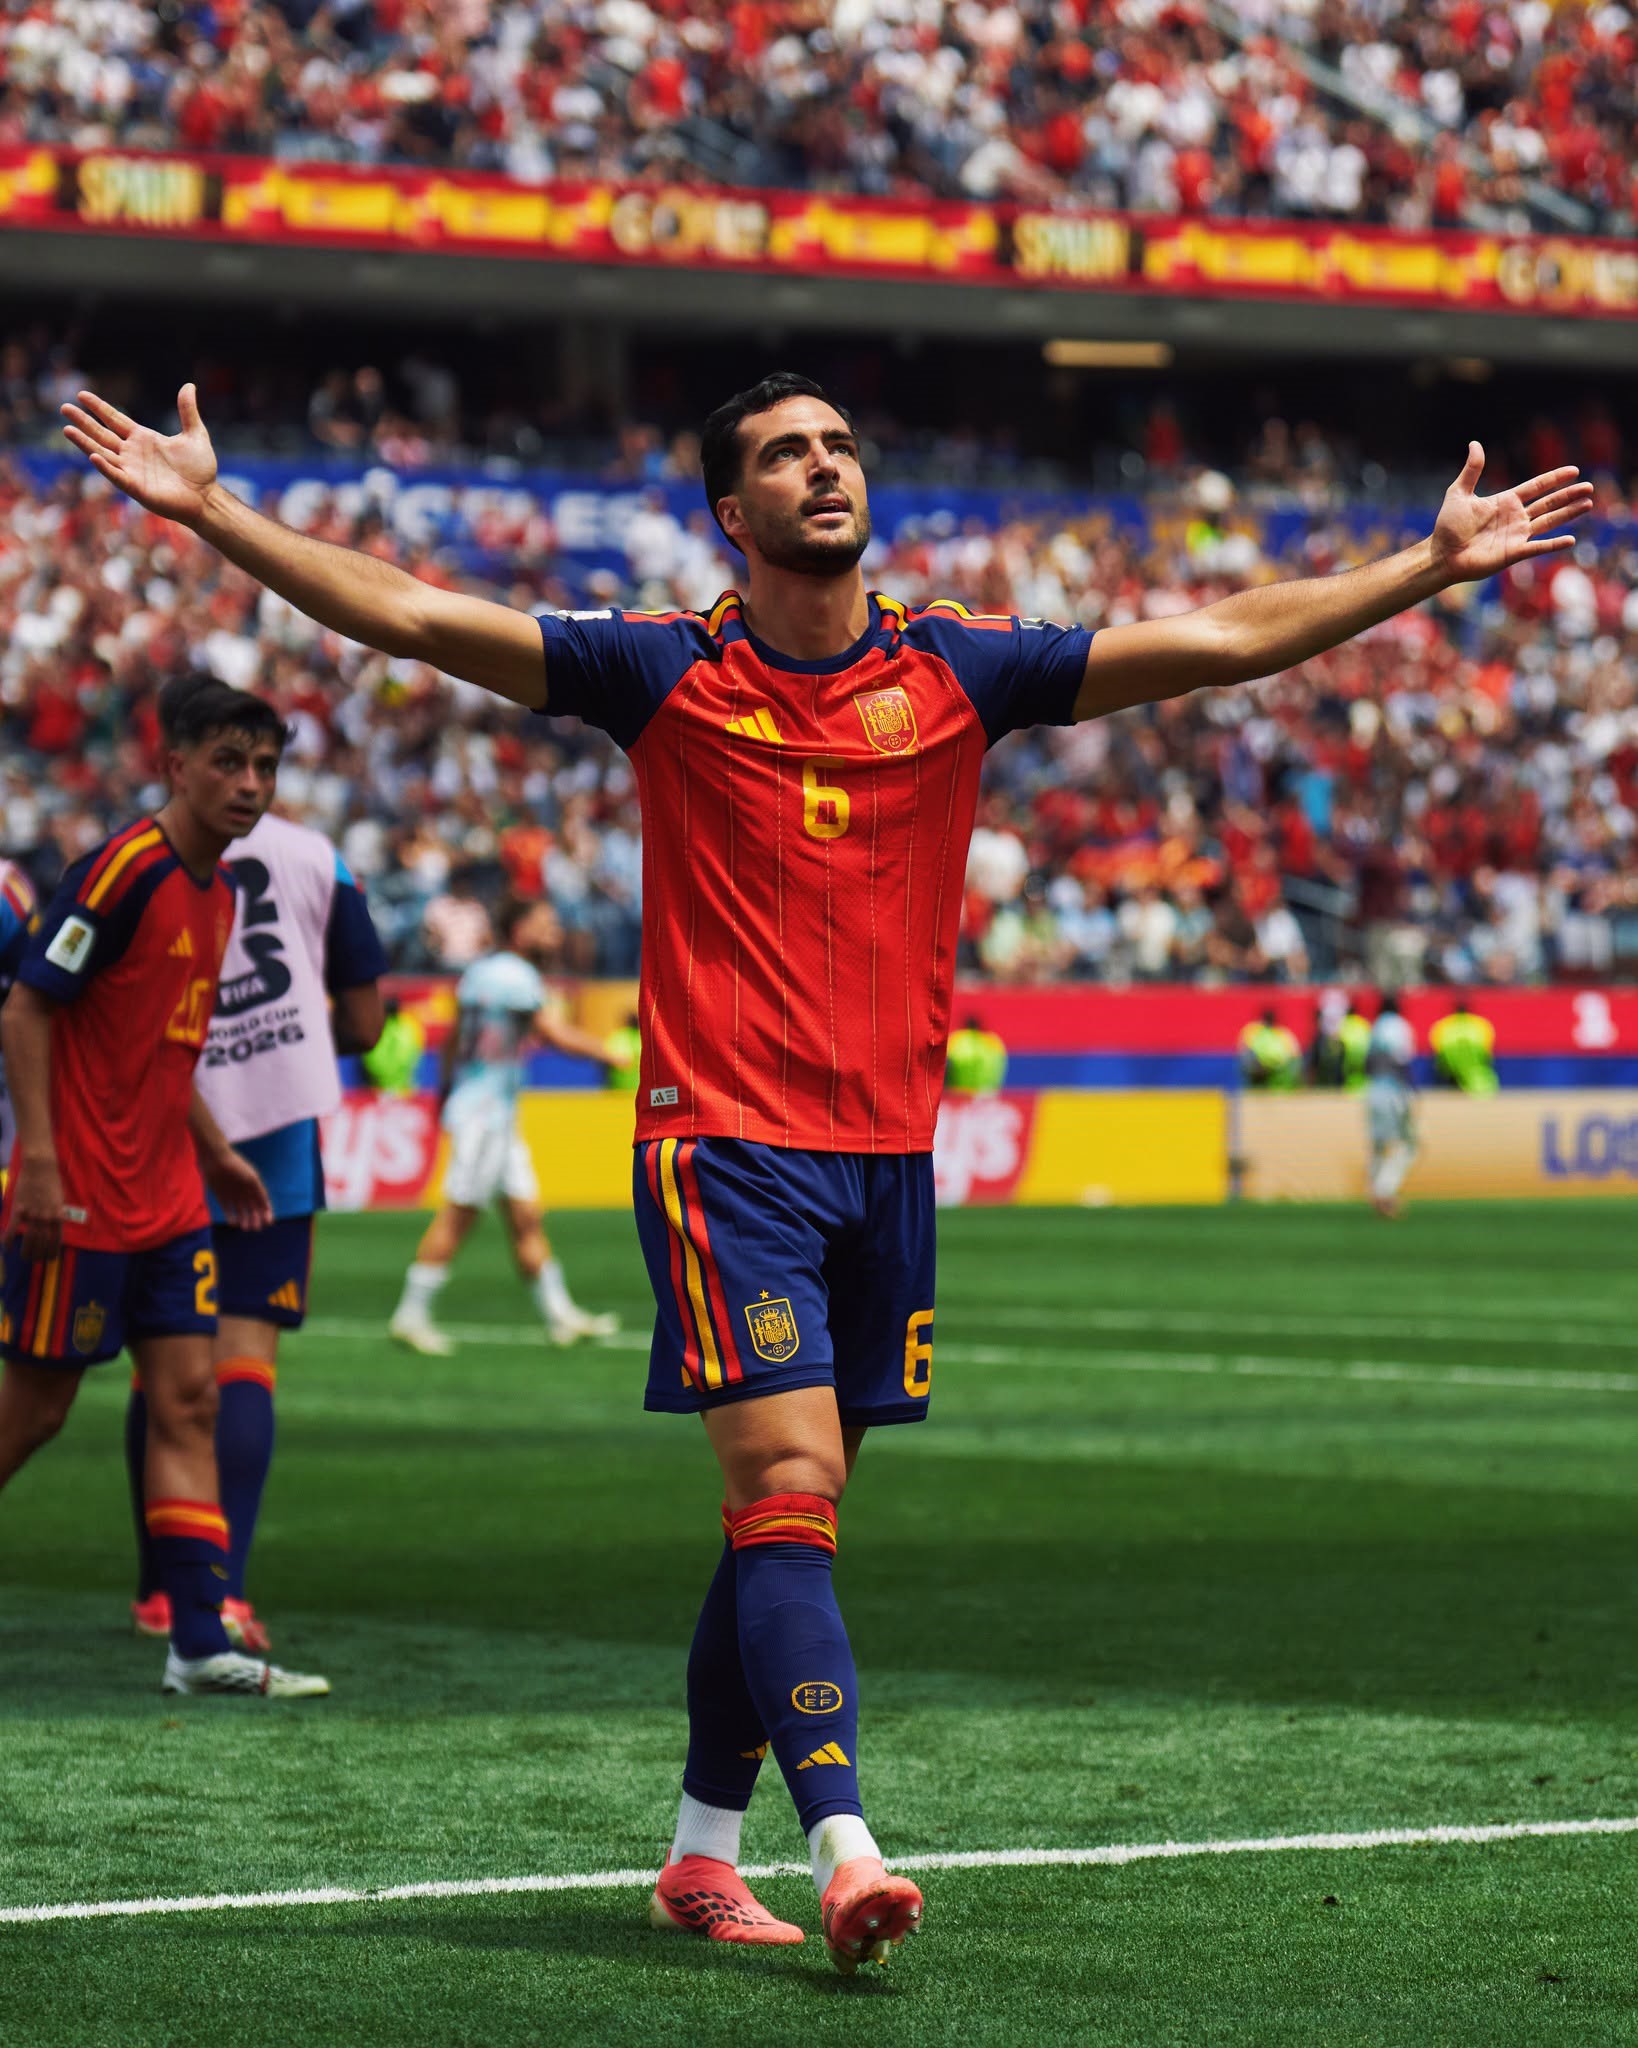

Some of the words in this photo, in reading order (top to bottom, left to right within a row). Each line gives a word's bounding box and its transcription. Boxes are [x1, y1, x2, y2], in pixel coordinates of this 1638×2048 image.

[803, 756, 850, 837] 6
[219, 975, 267, 1007] FIFA
[263, 1005, 300, 1025] CUP
[203, 1023, 305, 1068] 2026
[904, 1309, 934, 1398] 6
